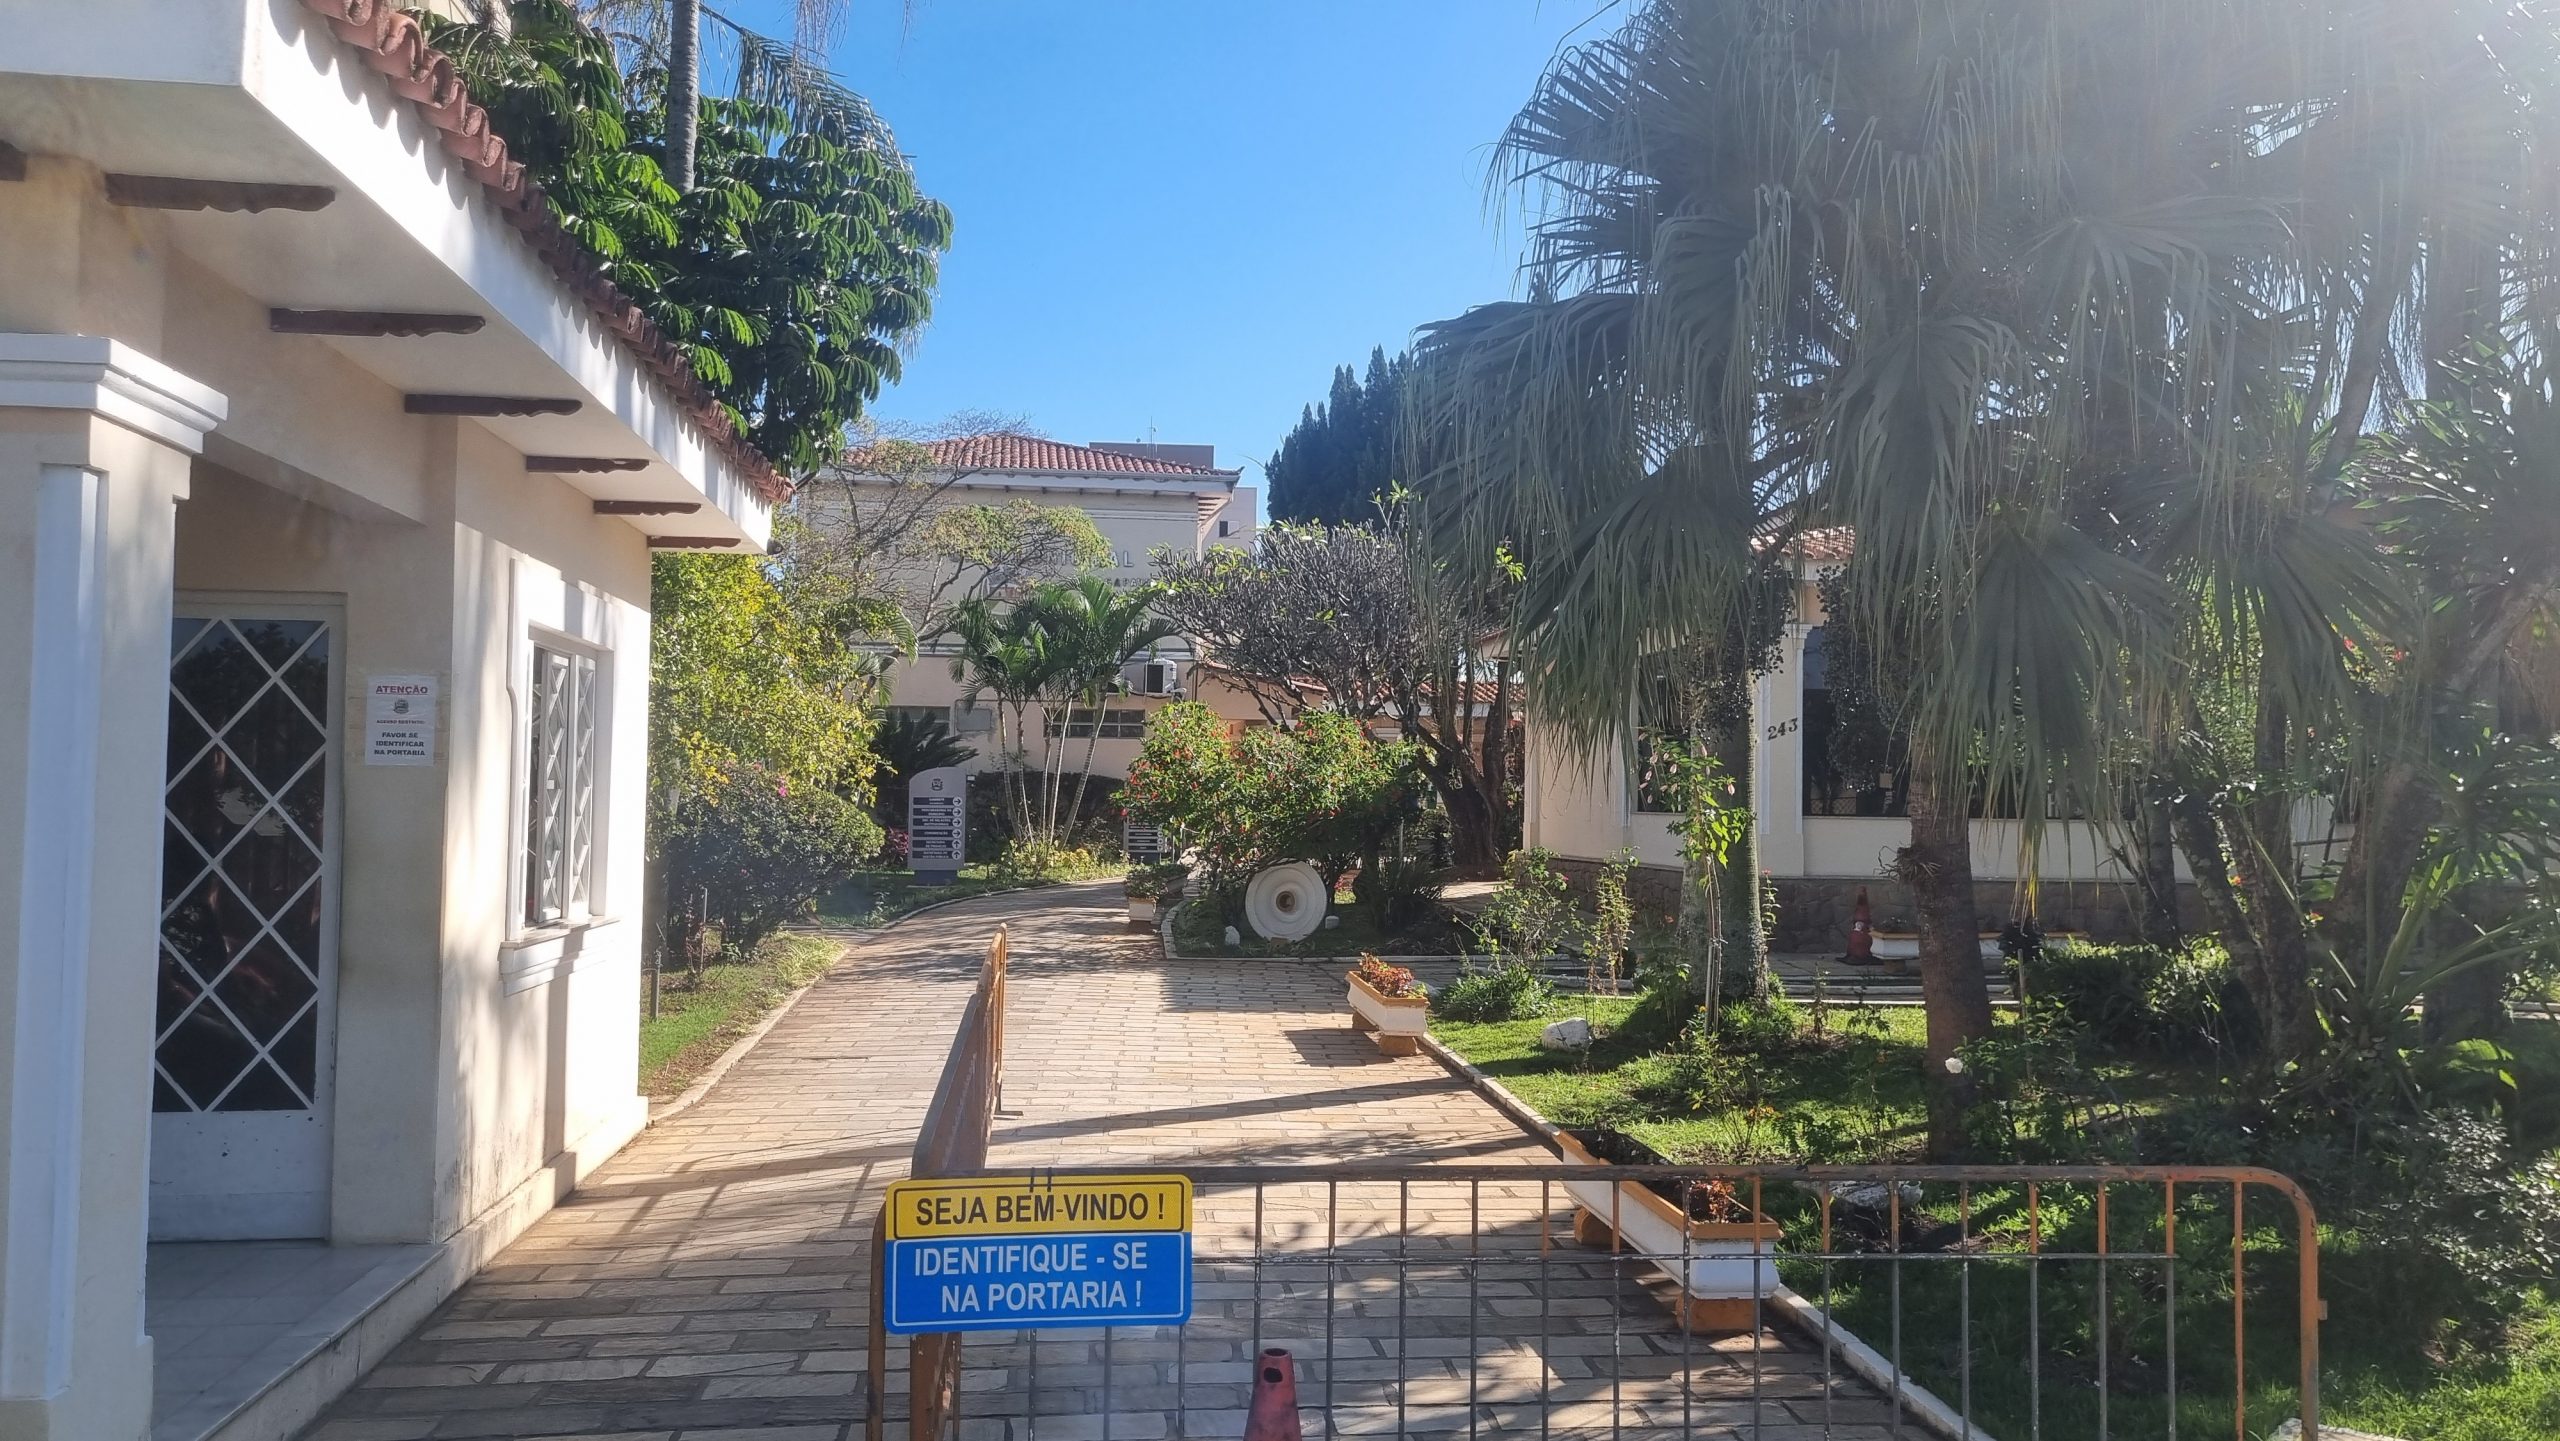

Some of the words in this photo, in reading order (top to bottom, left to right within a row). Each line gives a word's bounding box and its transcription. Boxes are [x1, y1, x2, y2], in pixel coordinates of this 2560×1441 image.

[376, 685, 428, 695] ATENÇÃO
[381, 731, 407, 739] FAVOR
[408, 731, 418, 739] SE
[1767, 717, 1798, 741] 243
[375, 740, 425, 748] IDENTIFICAR
[387, 749, 426, 757] PORTARIA
[915, 1196, 988, 1226] SEJA
[914, 1242, 1088, 1277] IDENTIFIQUE
[1112, 1241, 1148, 1270] SE
[941, 1283, 980, 1313] NA
[988, 1280, 1127, 1312] PORTARIA
